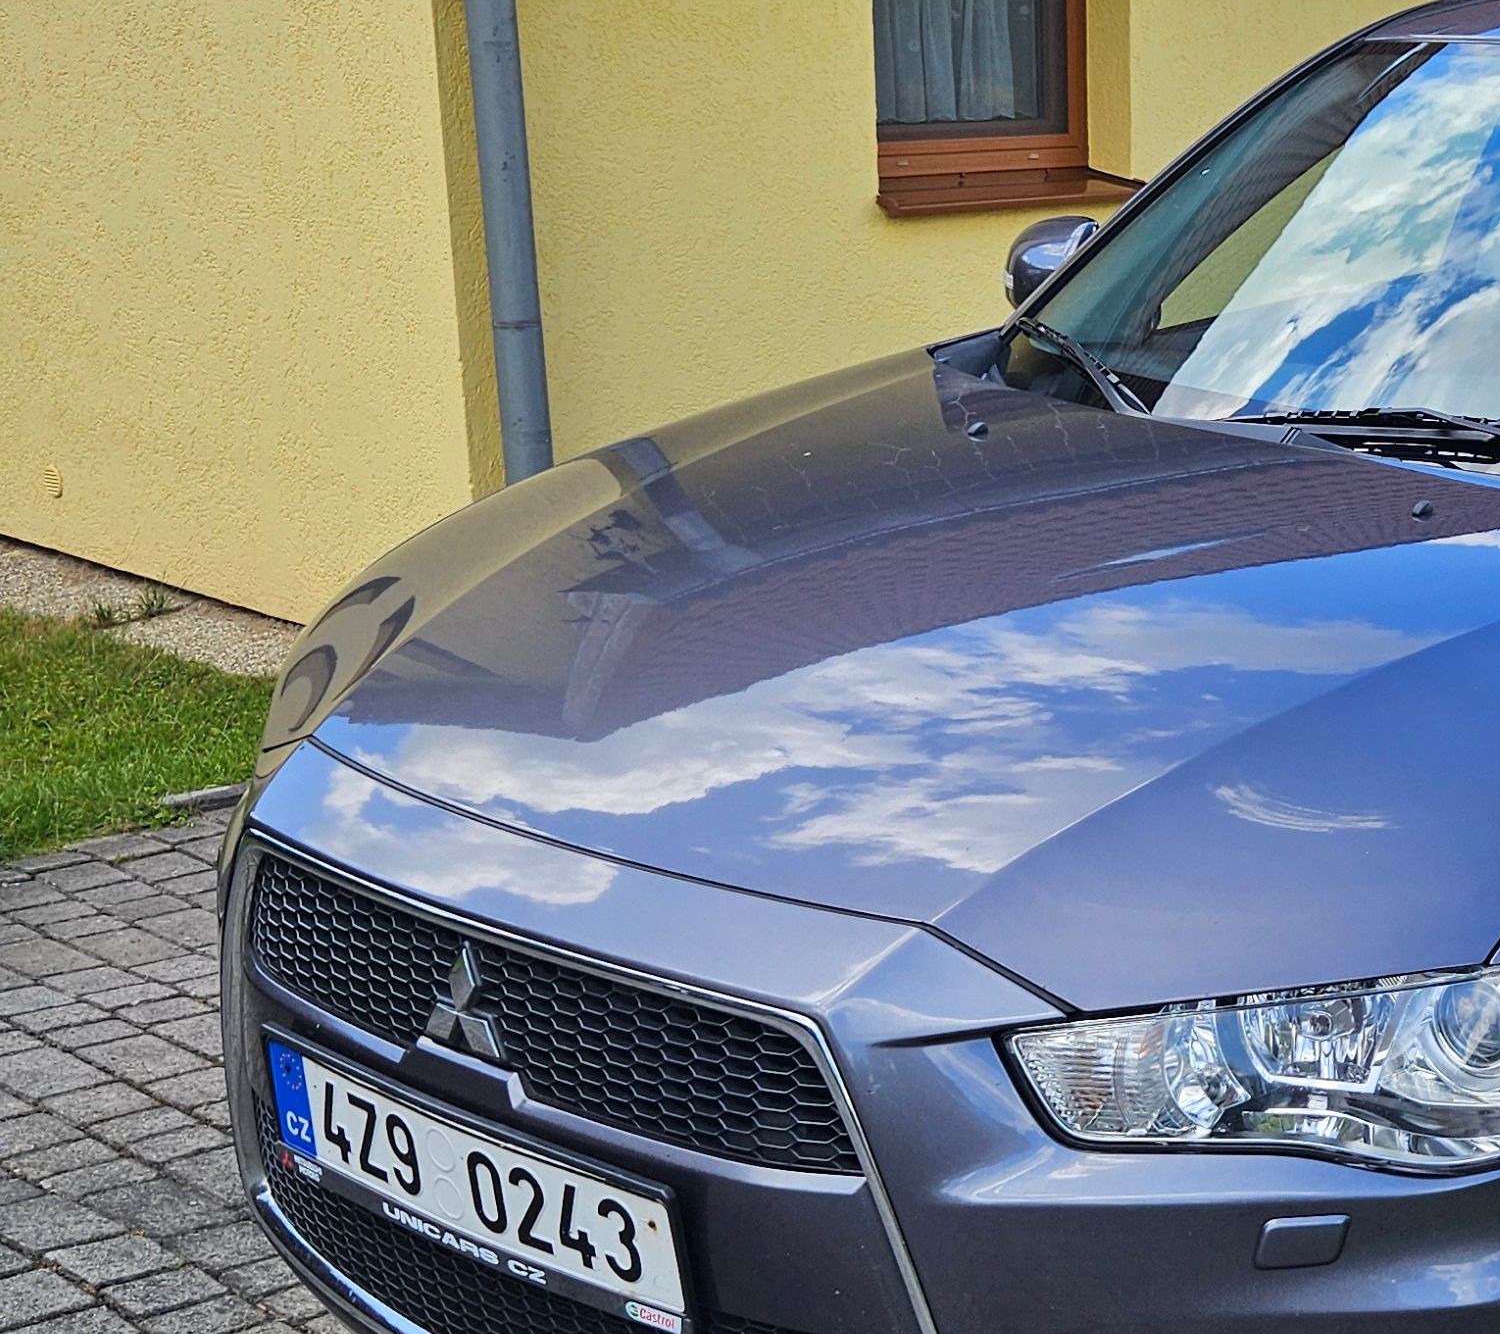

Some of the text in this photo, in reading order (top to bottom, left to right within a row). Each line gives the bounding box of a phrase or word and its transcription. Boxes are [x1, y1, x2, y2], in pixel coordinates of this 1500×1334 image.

[286, 1111, 312, 1143] CZ
[323, 1082, 642, 1283] 4Z9 0243
[383, 1202, 547, 1285] UNICARS CZ
[638, 1307, 676, 1330] Castrol
